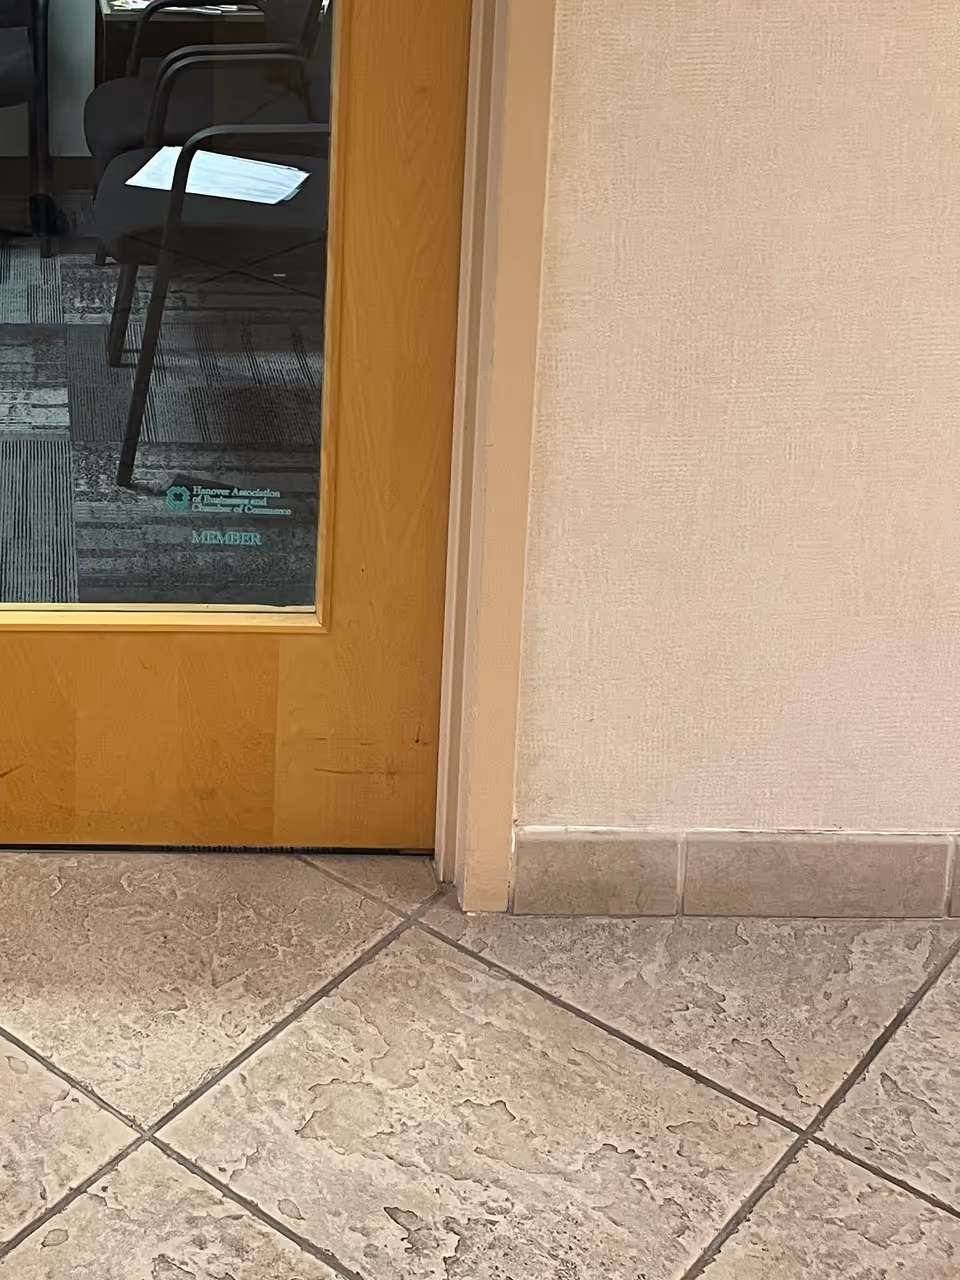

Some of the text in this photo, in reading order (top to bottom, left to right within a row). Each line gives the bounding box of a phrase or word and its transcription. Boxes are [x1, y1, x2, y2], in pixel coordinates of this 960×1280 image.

[192, 486, 280, 497] Hanover Association
[192, 495, 202, 503] of
[251, 497, 267, 505] and
[191, 504, 291, 515] Chamber of Commerce
[191, 530, 262, 545] MEMBER
